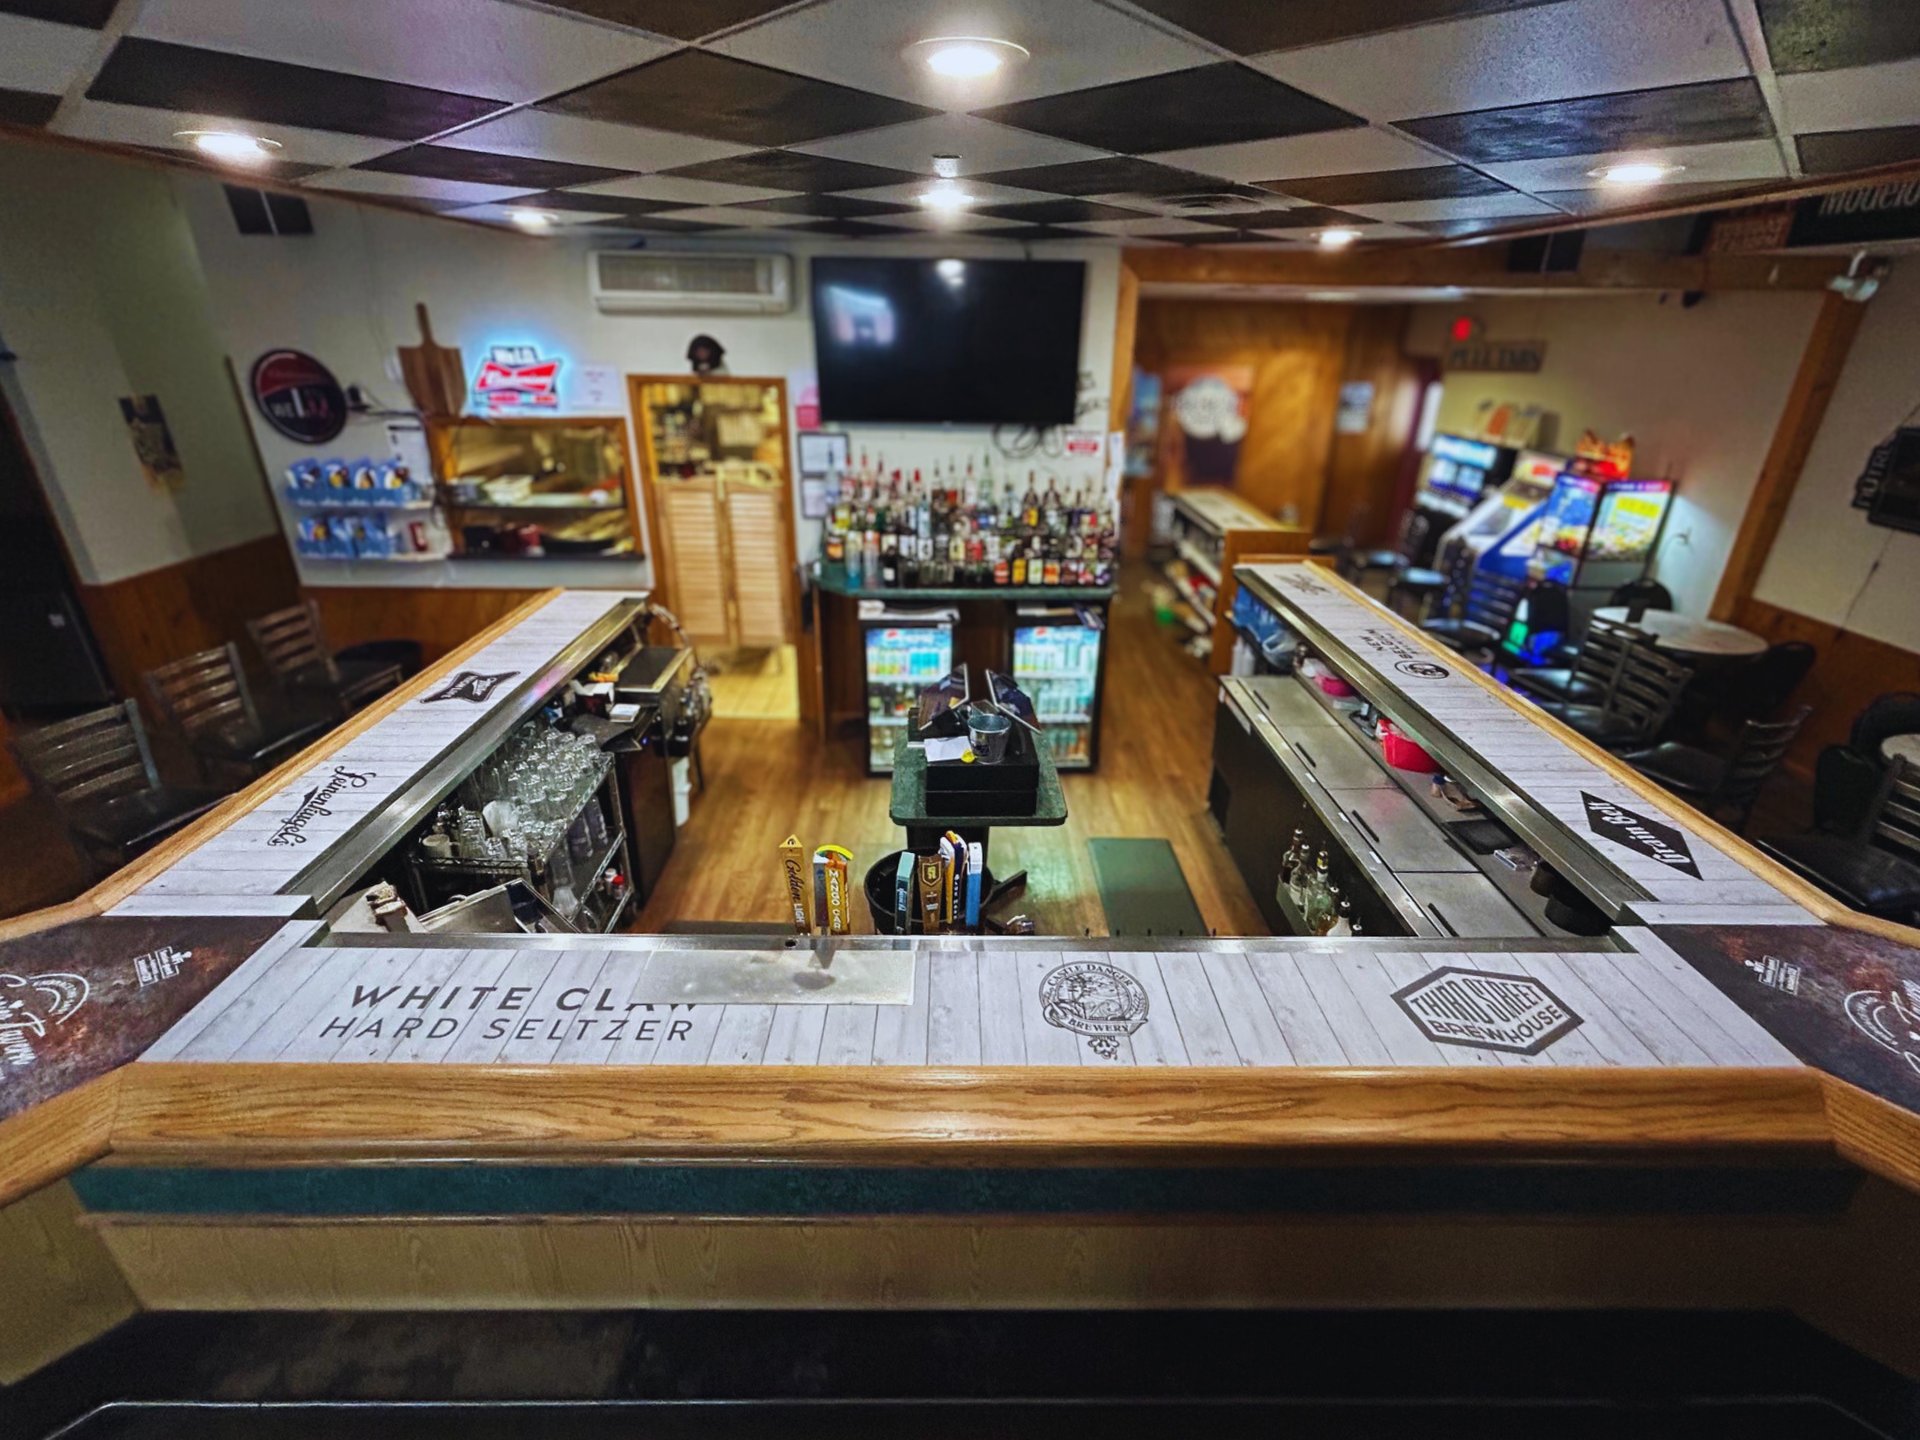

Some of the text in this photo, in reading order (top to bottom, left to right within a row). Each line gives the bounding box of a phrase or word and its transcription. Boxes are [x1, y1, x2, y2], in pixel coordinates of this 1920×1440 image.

[1587, 801, 1691, 864] Grain Belt
[828, 869, 841, 906] MANGO
[793, 903, 806, 924] LIGH
[1087, 964, 1134, 987] DANGER
[350, 984, 532, 1011] WHITE
[1410, 977, 1544, 1025] THIRD STREET
[318, 1016, 694, 1042] HARD SELTZER
[1067, 1018, 1130, 1033] BREWERY
